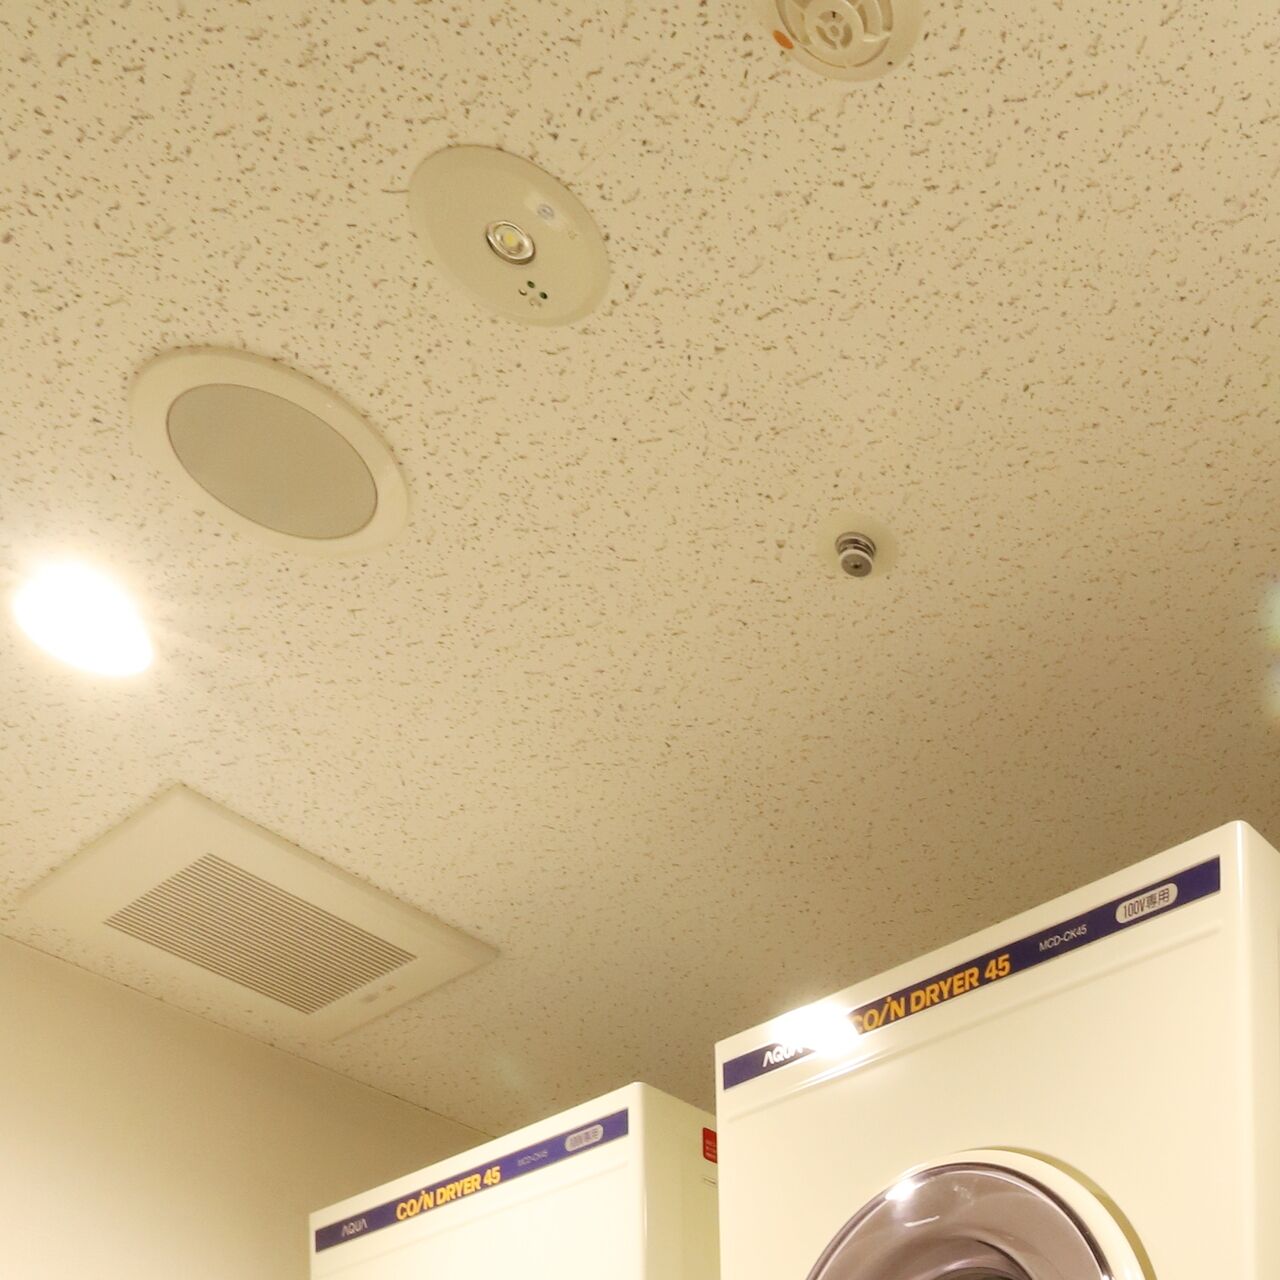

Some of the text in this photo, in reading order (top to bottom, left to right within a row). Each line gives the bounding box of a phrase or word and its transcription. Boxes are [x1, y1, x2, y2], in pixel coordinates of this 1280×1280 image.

[1123, 887, 1170, 919] 100V専用
[1038, 923, 1088, 952] MCD-CK45
[911, 966, 980, 1013] DRYER
[984, 953, 1012, 980] 45
[436, 1173, 482, 1207] DRYER
[483, 1165, 502, 1186] 45
[341, 1218, 368, 1237] AQUA
